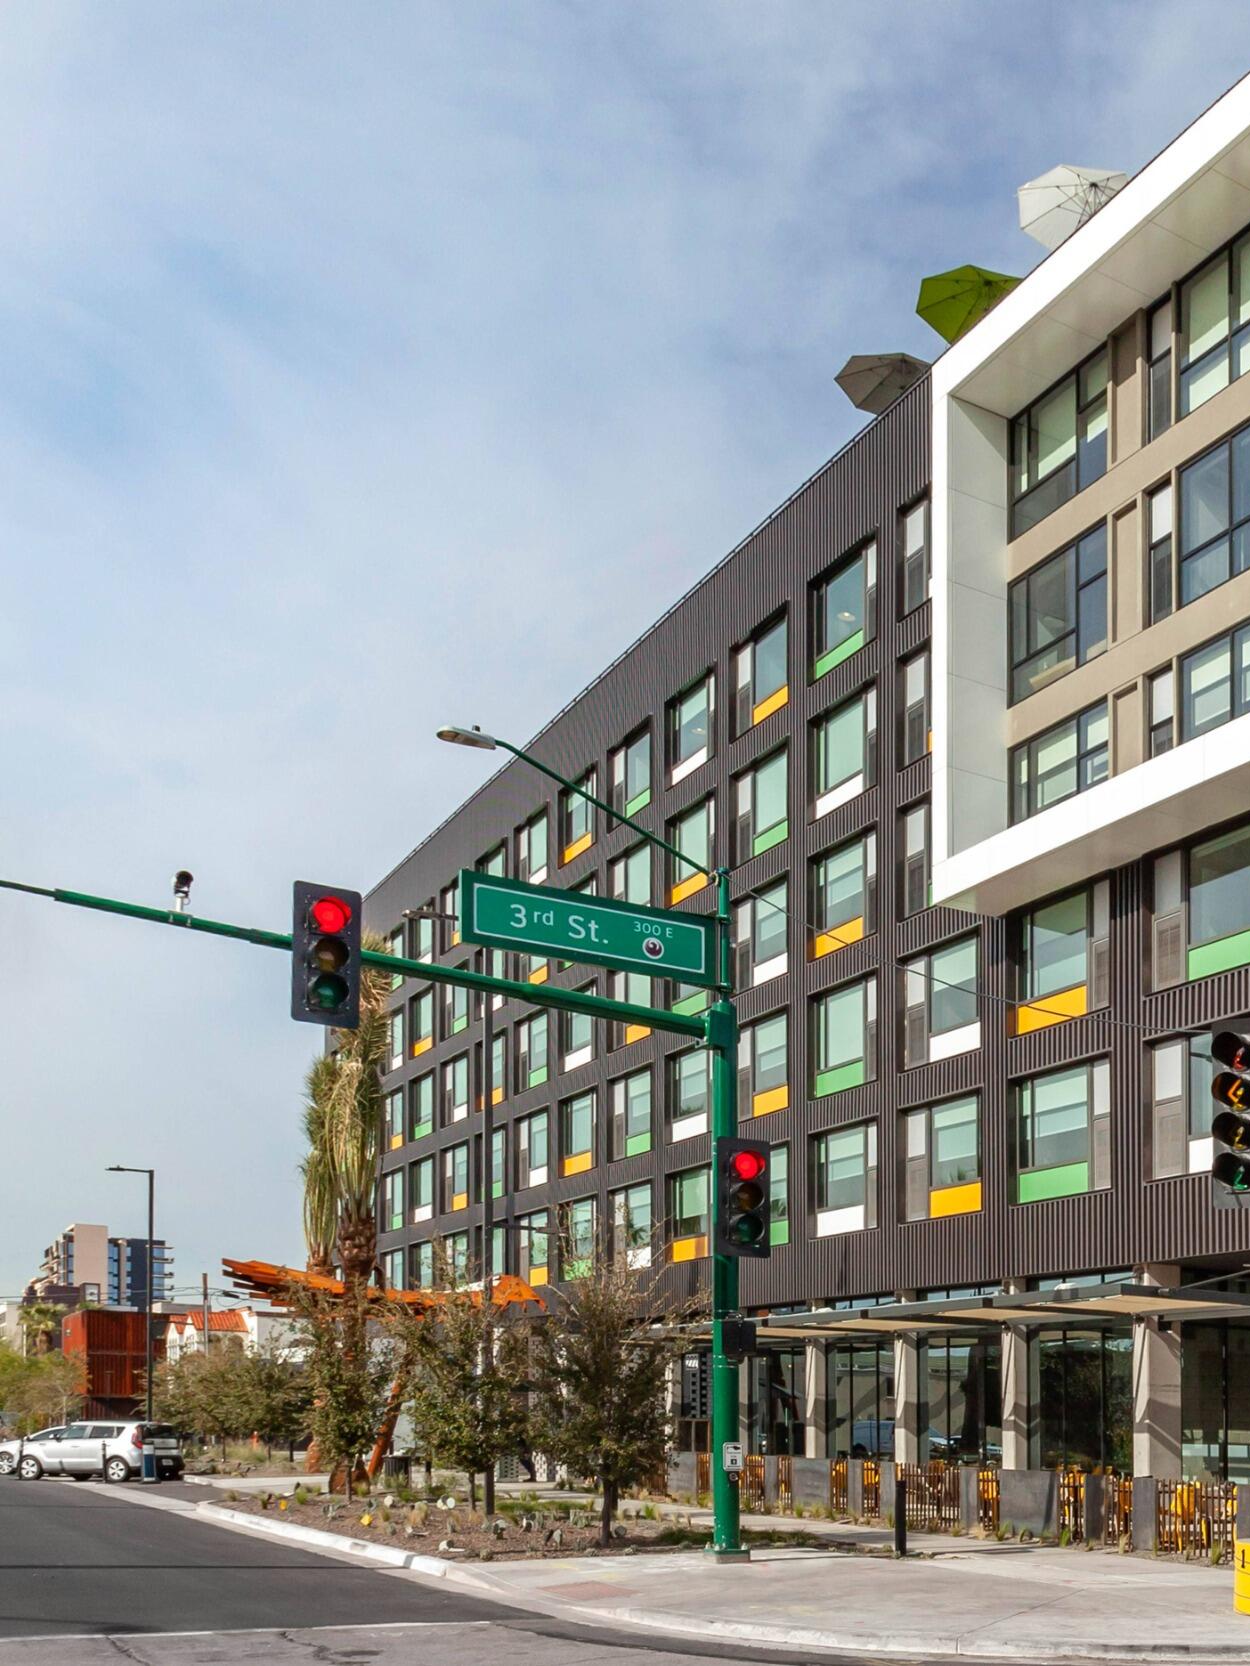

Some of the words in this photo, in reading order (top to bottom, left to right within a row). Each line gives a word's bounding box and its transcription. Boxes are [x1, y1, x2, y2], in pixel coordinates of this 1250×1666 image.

[510, 904, 554, 929] 3rd
[568, 915, 609, 944] St.
[633, 921, 661, 936] 300
[665, 927, 673, 939] E
